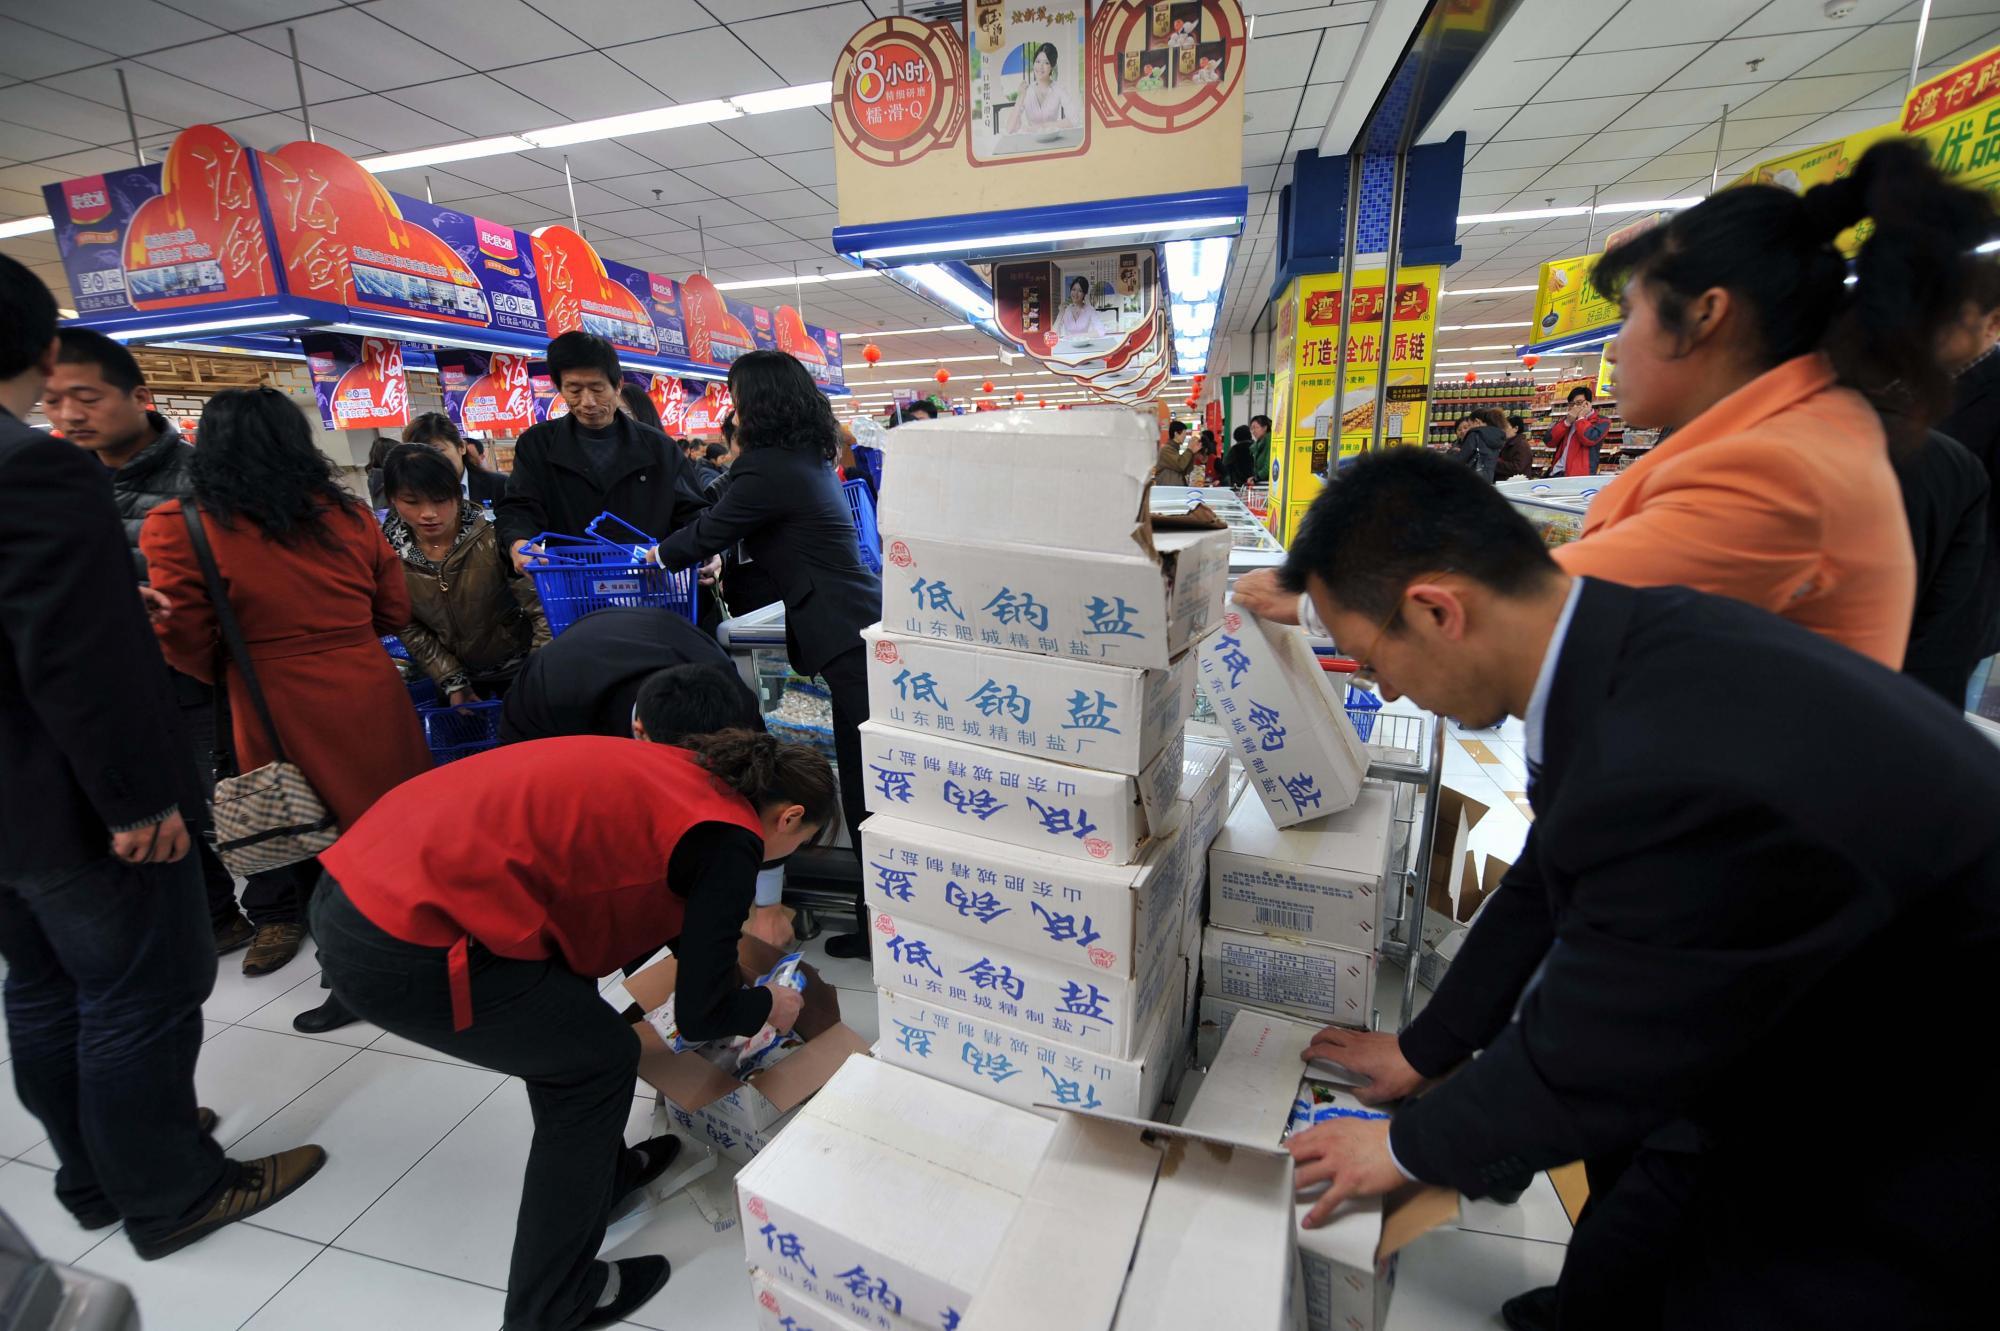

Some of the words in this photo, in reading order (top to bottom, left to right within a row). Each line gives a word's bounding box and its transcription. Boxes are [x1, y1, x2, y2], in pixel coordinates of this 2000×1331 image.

[1311, 289, 1422, 320] 湾仔码头
[906, 616, 1121, 657] 山东肥城精制盐厂
[910, 577, 1145, 639] 低钠盐
[890, 706, 1096, 753] 山东肥城精制盐厂
[892, 668, 1121, 734] 低钠盐
[1215, 634, 1323, 817] 低钠盐
[1201, 658, 1288, 811] 山东肥城精制盐厂
[869, 764, 1098, 839] 低钠盐
[877, 748, 1076, 797] 山东肥城精制盐厂
[870, 861, 1101, 948] 低钠盐
[879, 847, 1082, 902] 山东肥城精制盐厂
[886, 934, 1114, 1024] 低钠盐
[903, 973, 1101, 1037] 山东肥城精制盐厂
[891, 1018, 1102, 1109] 低钠盐
